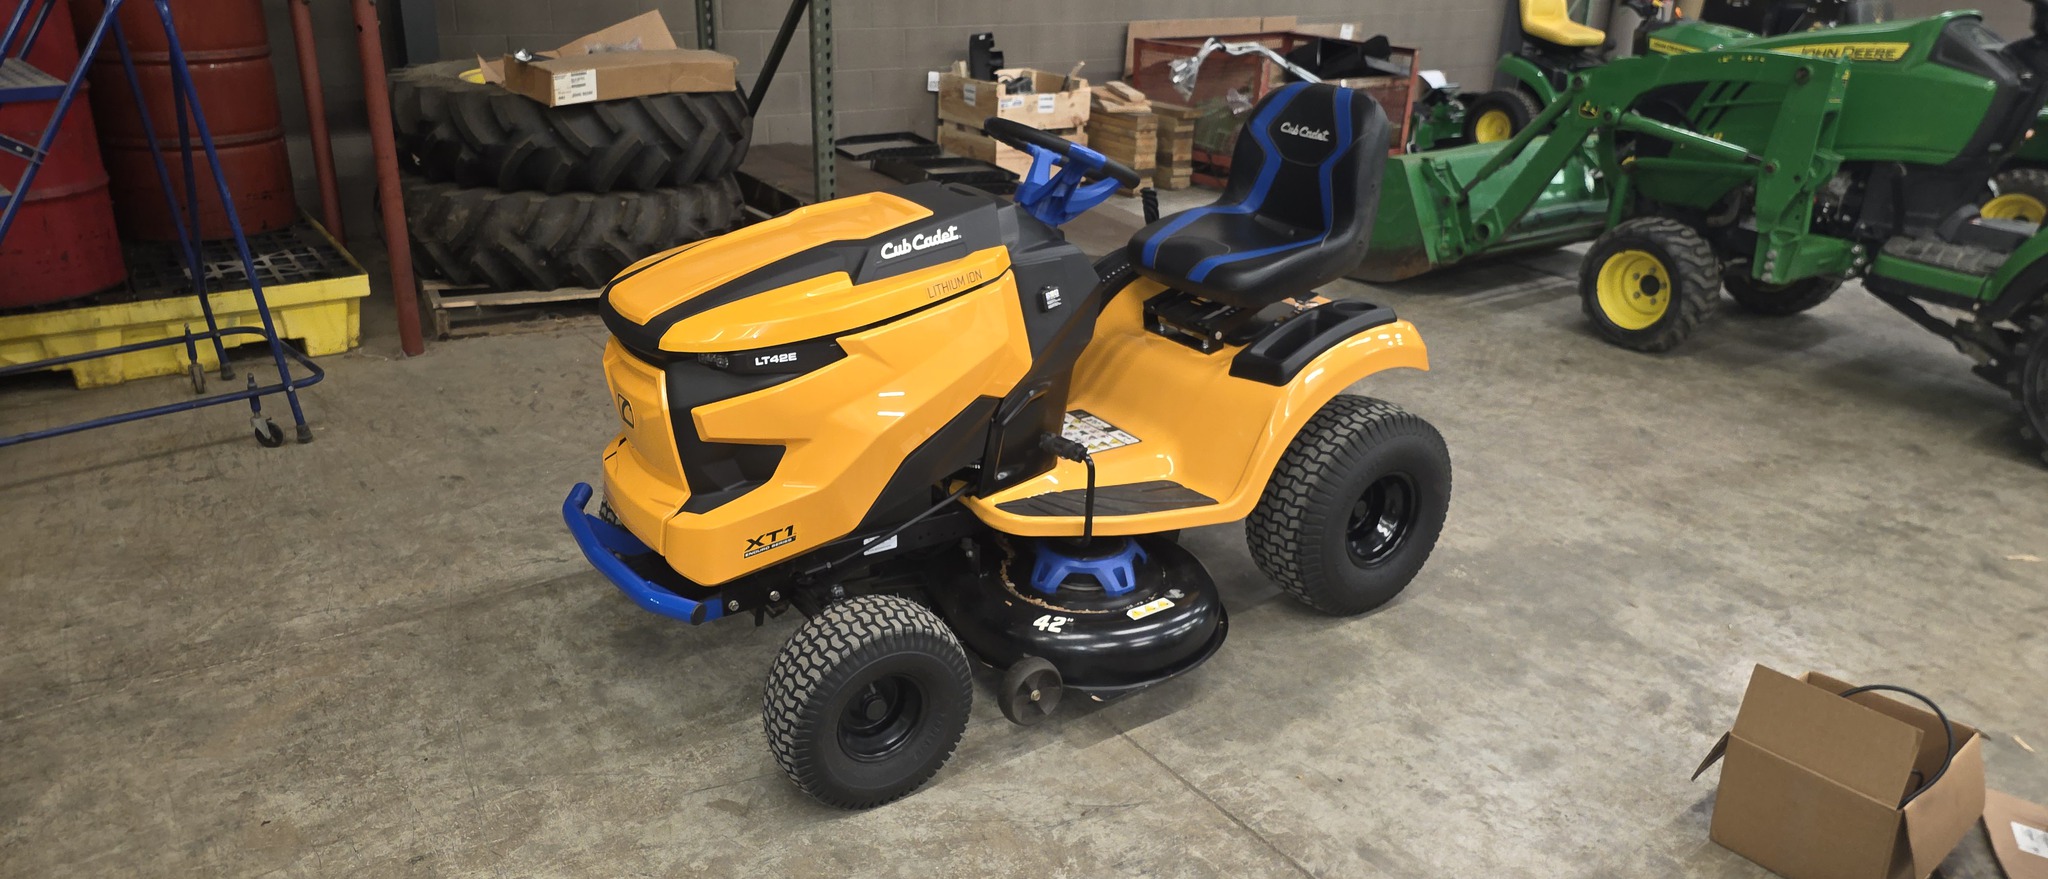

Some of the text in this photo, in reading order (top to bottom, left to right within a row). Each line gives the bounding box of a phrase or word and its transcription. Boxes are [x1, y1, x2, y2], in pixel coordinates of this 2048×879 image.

[1841, 46, 1896, 59] DEERE
[1281, 122, 1299, 135] Cub
[881, 226, 962, 259] Cub Cadet
[927, 269, 983, 299] LITHIUM ION
[755, 352, 798, 366] LT42E
[745, 524, 794, 552] XT1
